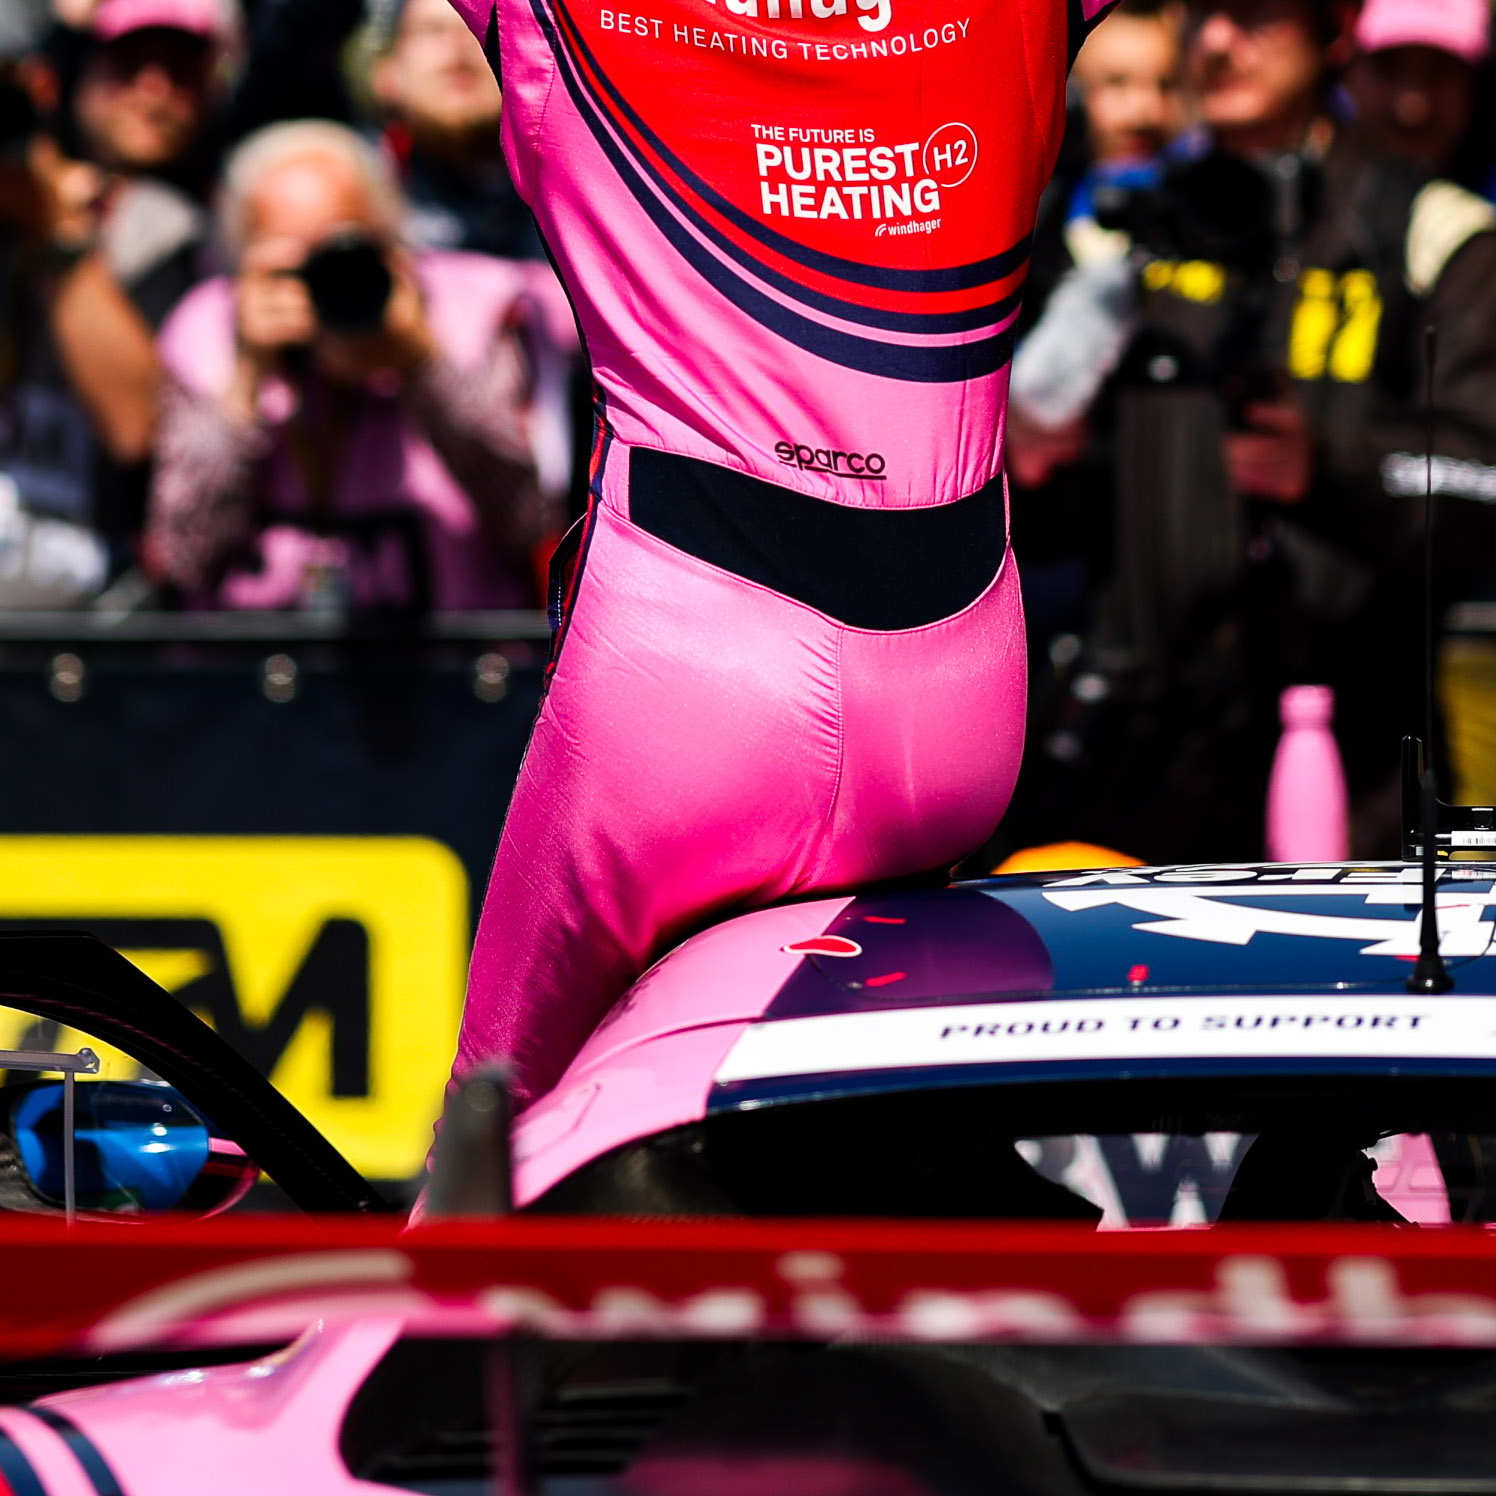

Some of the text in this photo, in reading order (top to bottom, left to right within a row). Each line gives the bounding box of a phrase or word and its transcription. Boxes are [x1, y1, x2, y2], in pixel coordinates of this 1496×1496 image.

[600, 8, 972, 61] BEST HEATING TECHNOLOGY
[750, 124, 875, 145] THE FUTURE IS
[755, 142, 920, 183] PUREST
[933, 139, 969, 172] H2
[760, 178, 942, 221] HEATING
[887, 217, 942, 238] windhager
[773, 439, 887, 476] sparco
[939, 1013, 1431, 1040] PROUD TO SUPPORT
